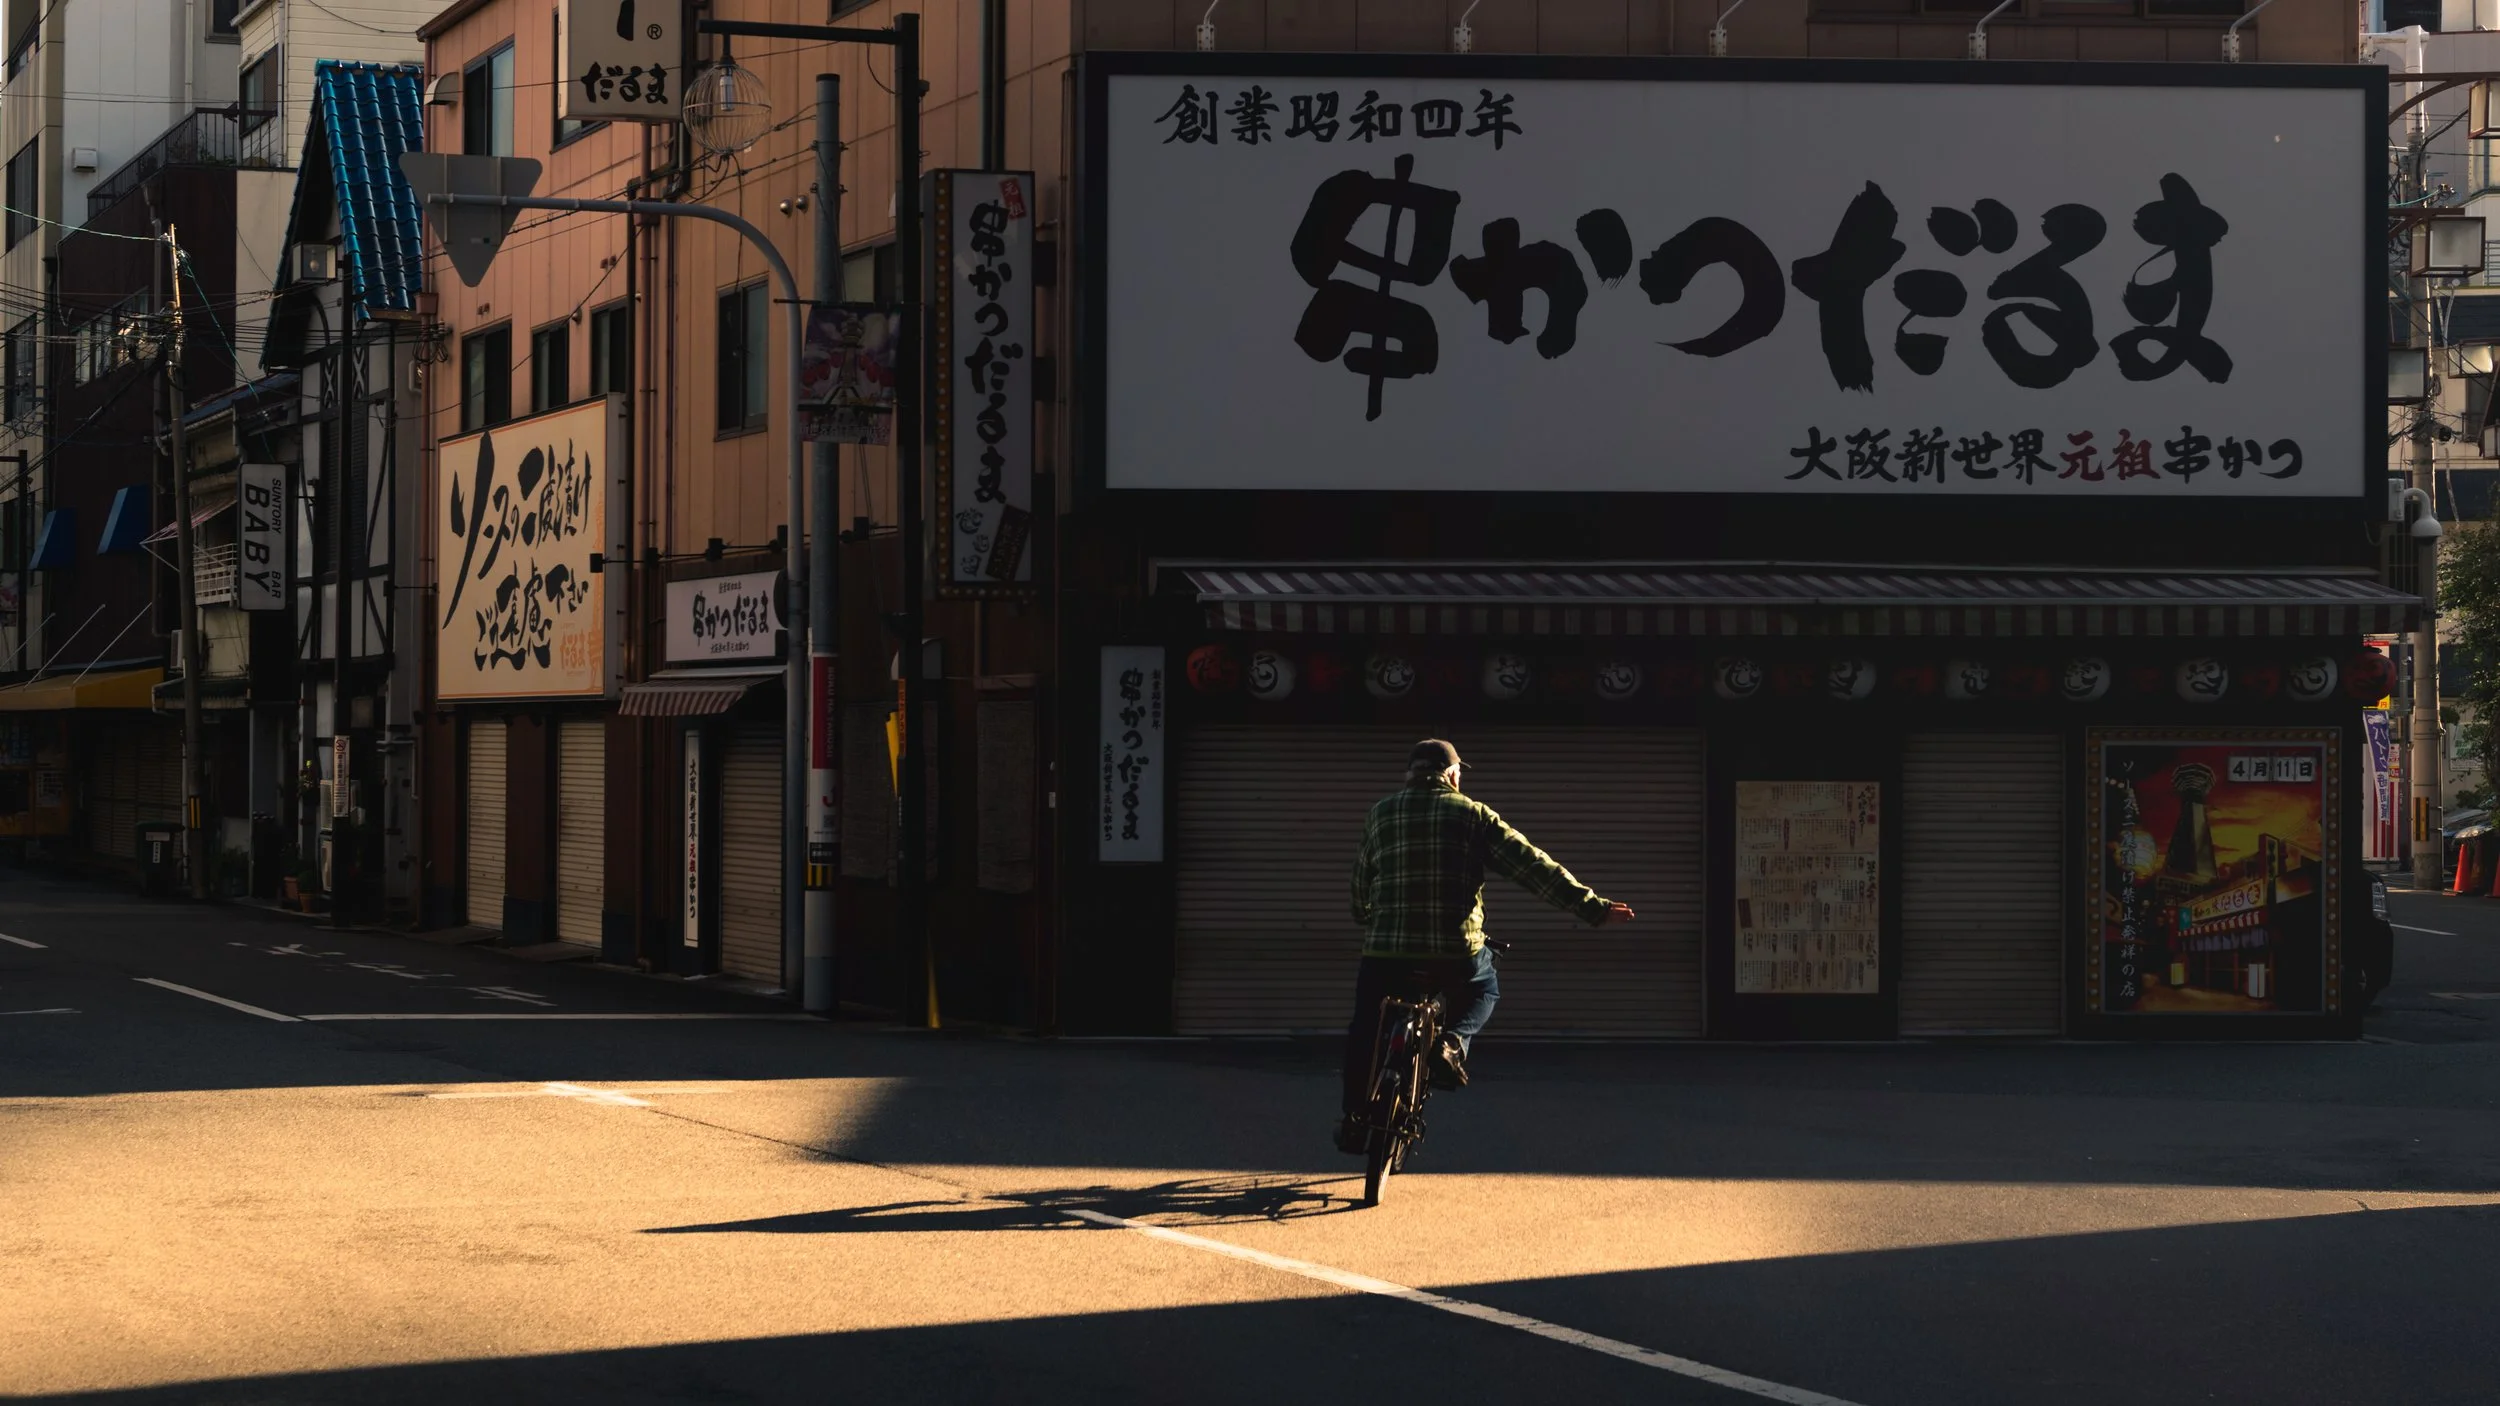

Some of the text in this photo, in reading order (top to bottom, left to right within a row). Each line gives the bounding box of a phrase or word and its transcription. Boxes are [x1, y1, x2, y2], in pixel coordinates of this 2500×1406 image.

[581, 62, 668, 104] だるま
[1154, 84, 1523, 150] 創業昭和四年
[1004, 182, 1024, 217] 元祖
[1290, 153, 2234, 420] 串かつだるま
[965, 200, 1023, 503] 串かつだるま
[1784, 425, 2303, 486] 大阪新世界元祖串かつ
[245, 483, 270, 593] BABY
[272, 478, 281, 599] SUNTORY BAR
[693, 590, 769, 647] 串かつだるま
[1117, 667, 1149, 841] 串かつだるま
[2120, 761, 2137, 997] ソース二度漬け禁止発祥の店
